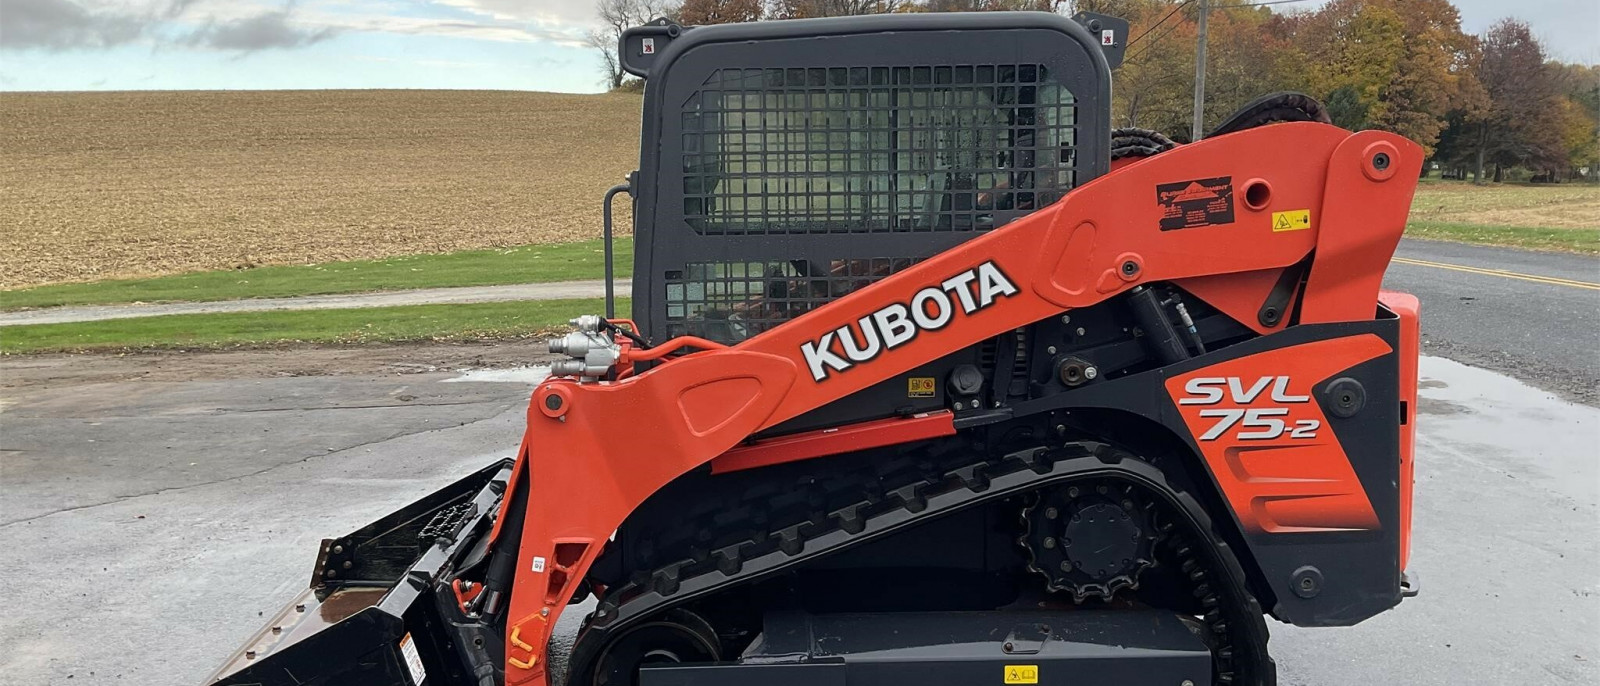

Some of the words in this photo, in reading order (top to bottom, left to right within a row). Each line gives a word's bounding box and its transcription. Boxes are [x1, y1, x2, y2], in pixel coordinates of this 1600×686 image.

[800, 260, 1019, 382] KUBOTA
[1178, 375, 1311, 405] SVL
[1198, 407, 1321, 441] 75-2
